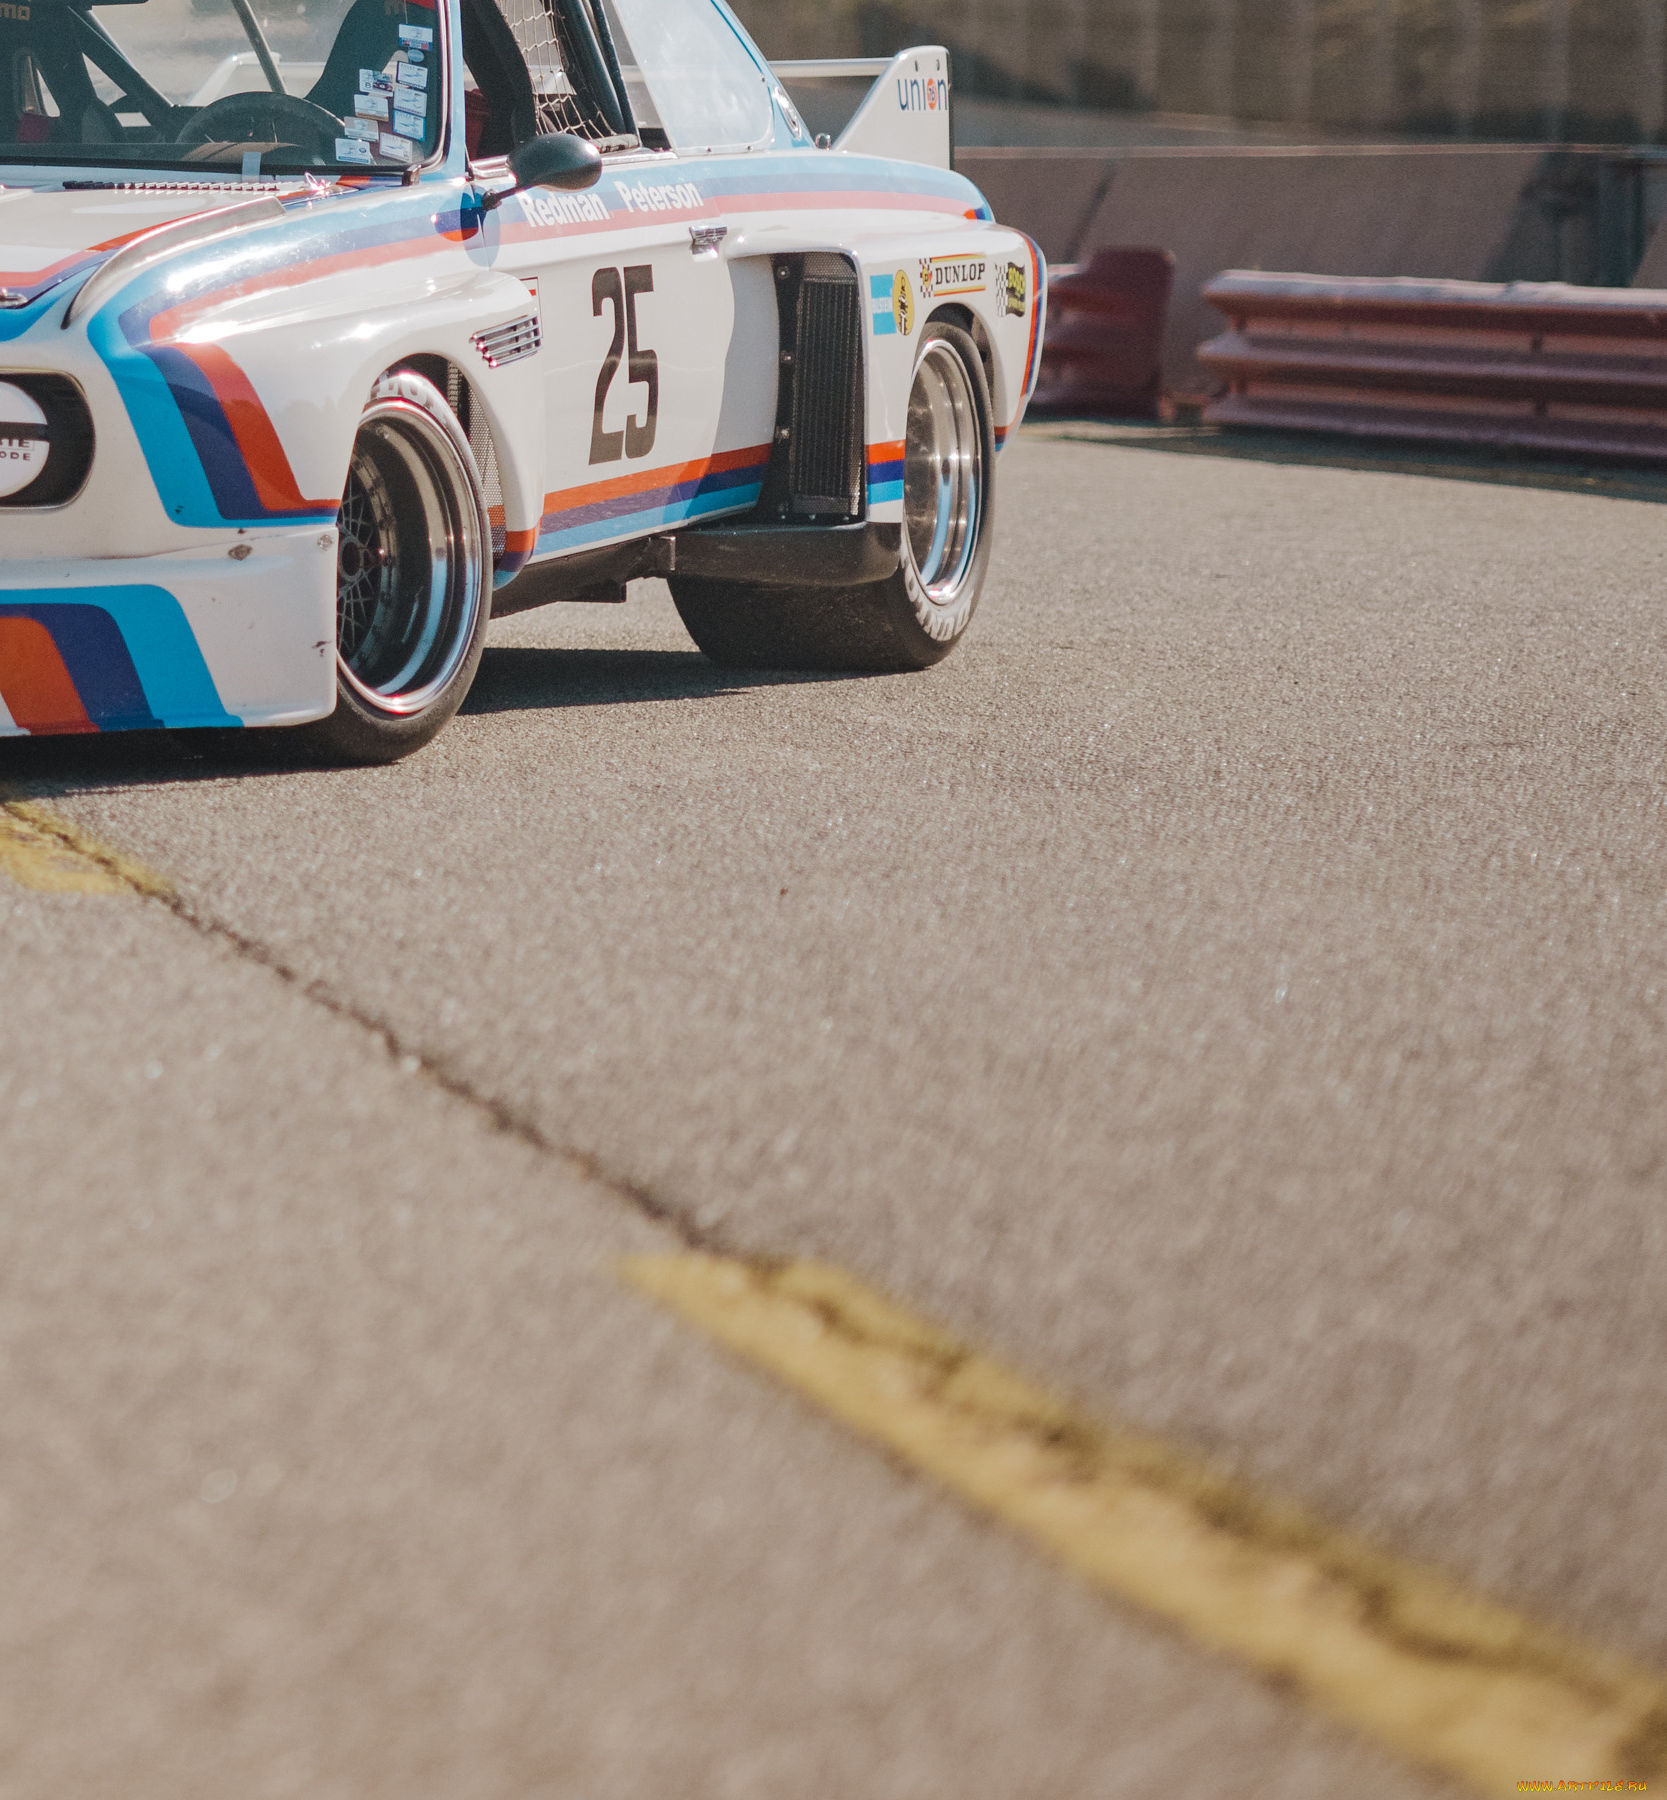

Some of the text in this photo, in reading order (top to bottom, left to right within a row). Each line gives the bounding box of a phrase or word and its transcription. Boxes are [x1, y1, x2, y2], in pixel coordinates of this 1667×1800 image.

[515, 179, 705, 228] Redman Peterson
[935, 262, 986, 286] DUNLOP
[588, 264, 659, 466] 25
